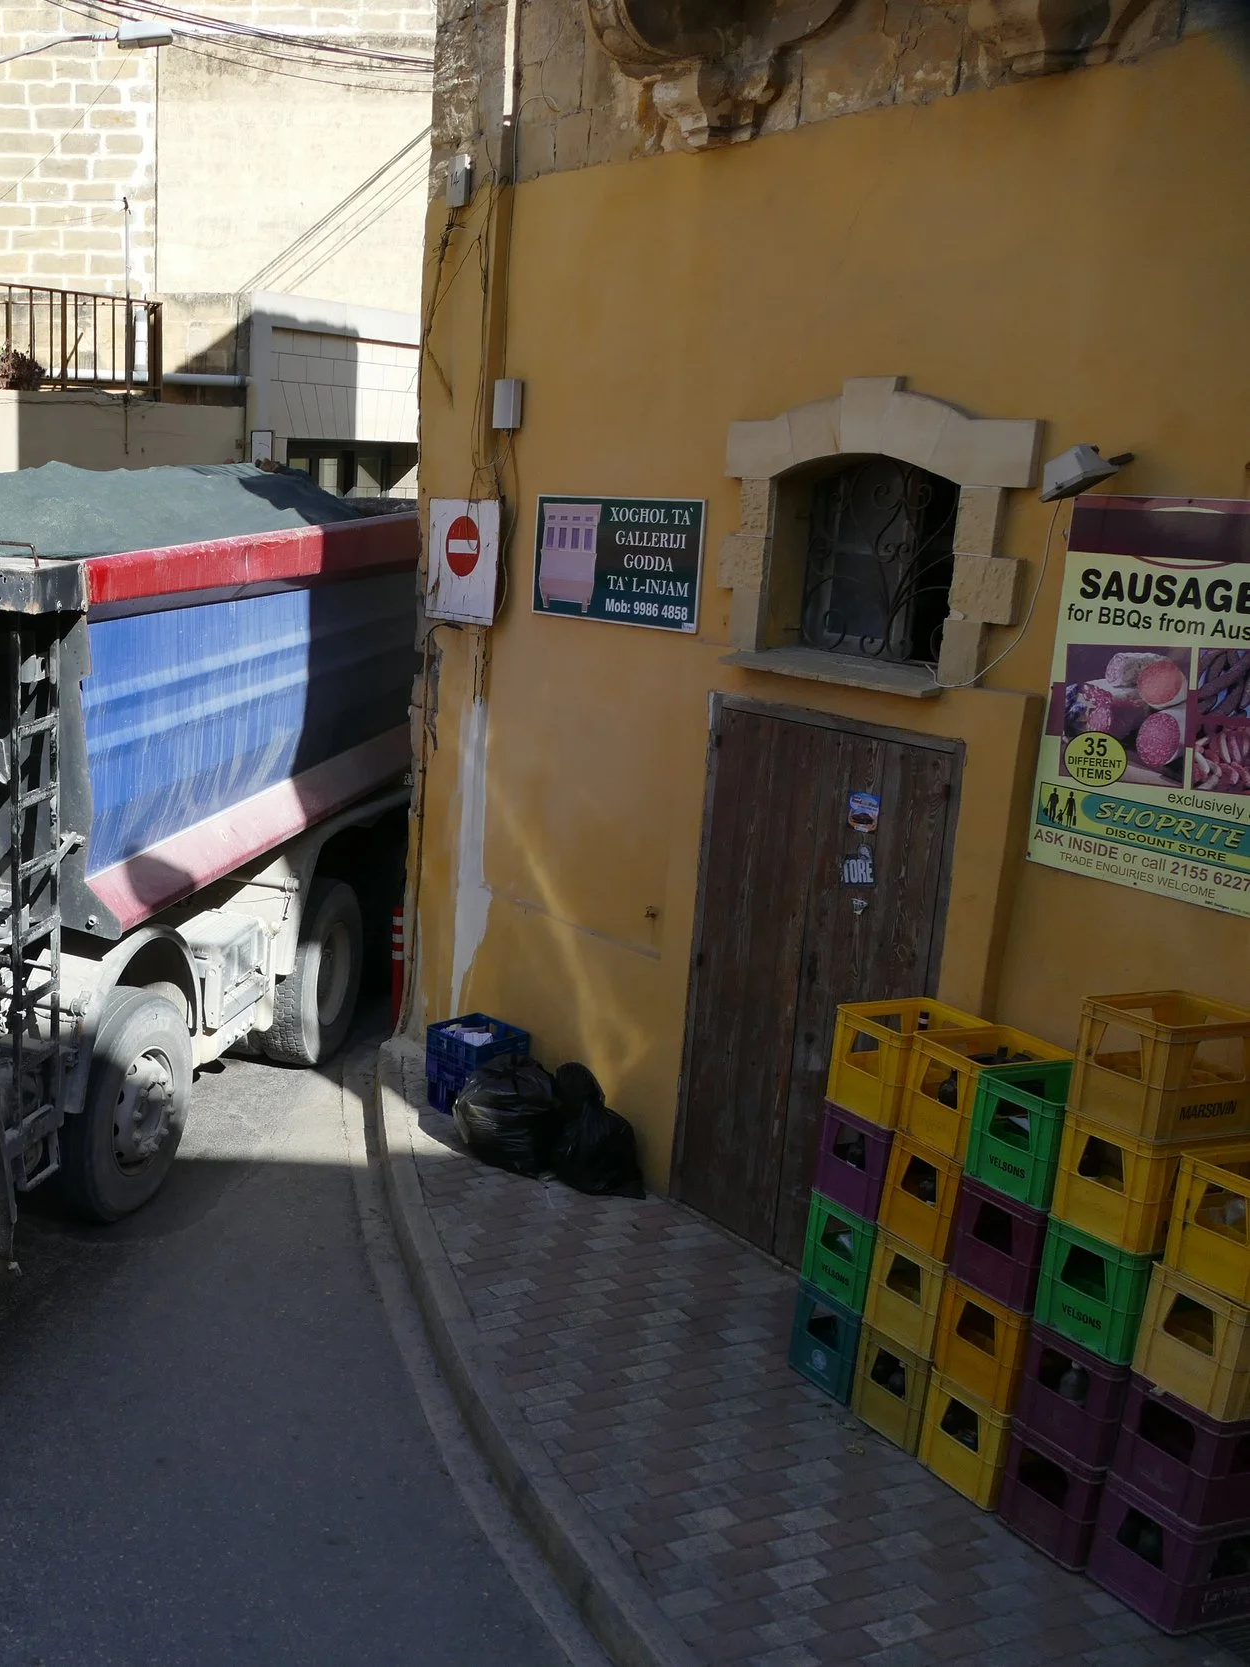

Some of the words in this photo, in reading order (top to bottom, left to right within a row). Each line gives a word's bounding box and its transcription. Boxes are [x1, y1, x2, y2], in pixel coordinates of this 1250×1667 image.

[610, 507, 668, 524] XOGĦOL
[615, 530, 686, 549] GALLERIJI
[624, 554, 673, 572] GODDA
[632, 578, 689, 597] L-INJAM
[605, 598, 630, 613] Mob:
[633, 601, 658, 617] 9986
[661, 605, 688, 620] 4858
[1067, 603, 1092, 622] for
[1098, 606, 1152, 630] BBQs
[1159, 613, 1205, 636] from
[1084, 737, 1107, 756] 35
[1068, 756, 1122, 769] DIFFERENT
[1076, 768, 1112, 780] ITEMS
[1168, 793, 1245, 819] exclusively
[1095, 802, 1245, 848] SHOPRITE
[1105, 827, 1175, 850] DISCOUNT
[1178, 843, 1227, 862] STORE
[1034, 829, 1064, 847] ASK
[1068, 836, 1119, 860] INSIDE
[1123, 851, 1138, 864] or
[1141, 855, 1166, 871] call
[1170, 862, 1208, 881] 2155
[1213, 872, 1250, 891] 6227
[1060, 851, 1092, 868] TRADE
[1096, 861, 1154, 883] ENQUIRIES
[1157, 877, 1216, 899] WELCOME
[989, 1154, 1025, 1179] VELSONS
[1062, 1302, 1102, 1330] VELSONS
